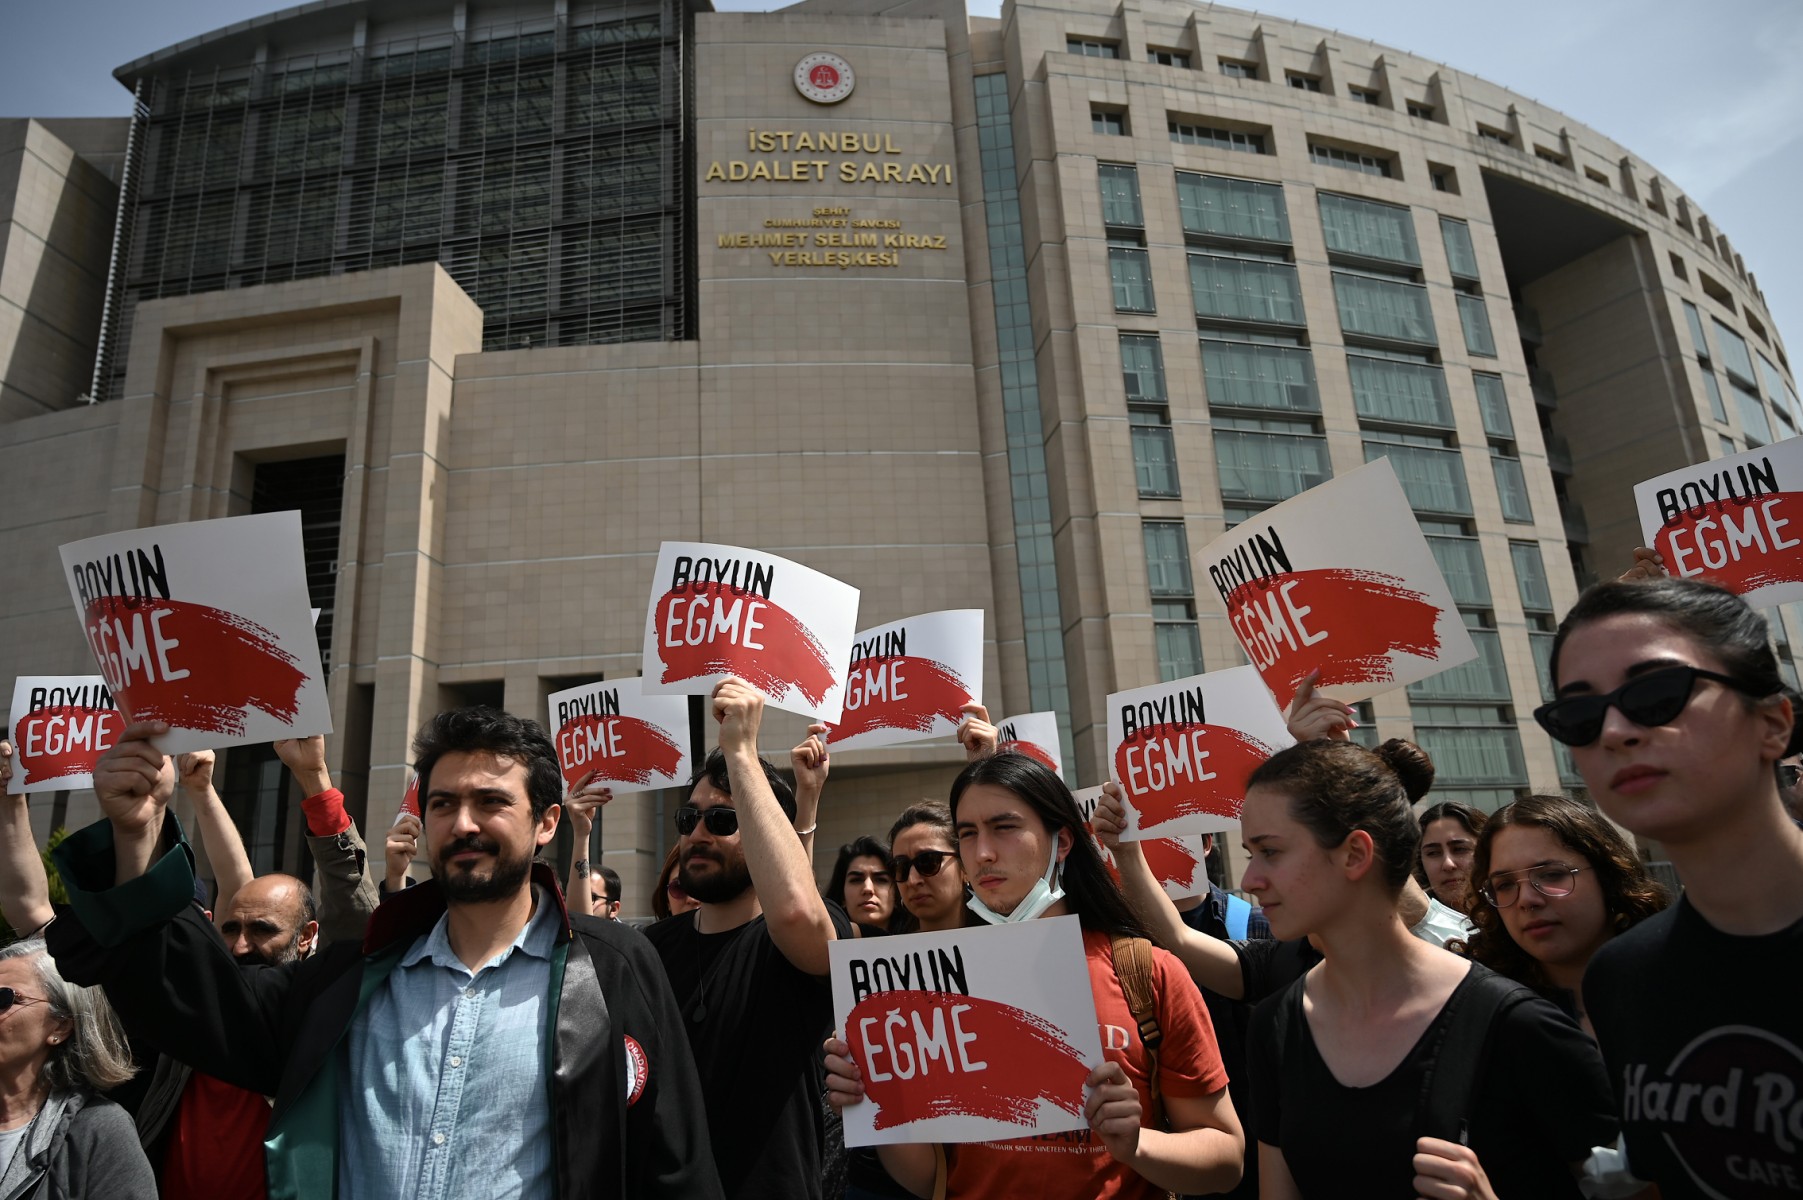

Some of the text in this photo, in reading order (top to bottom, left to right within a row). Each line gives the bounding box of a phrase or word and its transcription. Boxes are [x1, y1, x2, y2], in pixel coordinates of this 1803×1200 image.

[749, 128, 901, 154] İSTANBUL
[705, 160, 952, 185] ADALET SARAYI
[717, 230, 947, 250] MEHMET SELİM KİRAZ
[769, 249, 899, 269] YERLEŞKESİ
[1656, 457, 1779, 528] BOYUN
[1668, 498, 1801, 578] EĞME
[73, 544, 170, 617] BOYUN
[671, 556, 774, 600] BOYUN
[1209, 525, 1293, 612] BOYUN
[665, 593, 768, 651] EĞME
[1234, 580, 1328, 672] EĞME
[89, 608, 191, 692] EĞME
[849, 627, 906, 672] OYUN
[29, 684, 114, 717] BOYUN
[558, 687, 620, 731] BOYUN
[845, 660, 909, 710] ĞME
[26, 713, 112, 757] EĞME
[1121, 686, 1205, 744] BOYUN
[562, 720, 626, 770] EĞME
[1126, 729, 1217, 796] EĞME
[860, 1004, 988, 1083] EĞME
[1623, 1063, 1743, 1128] Hard
